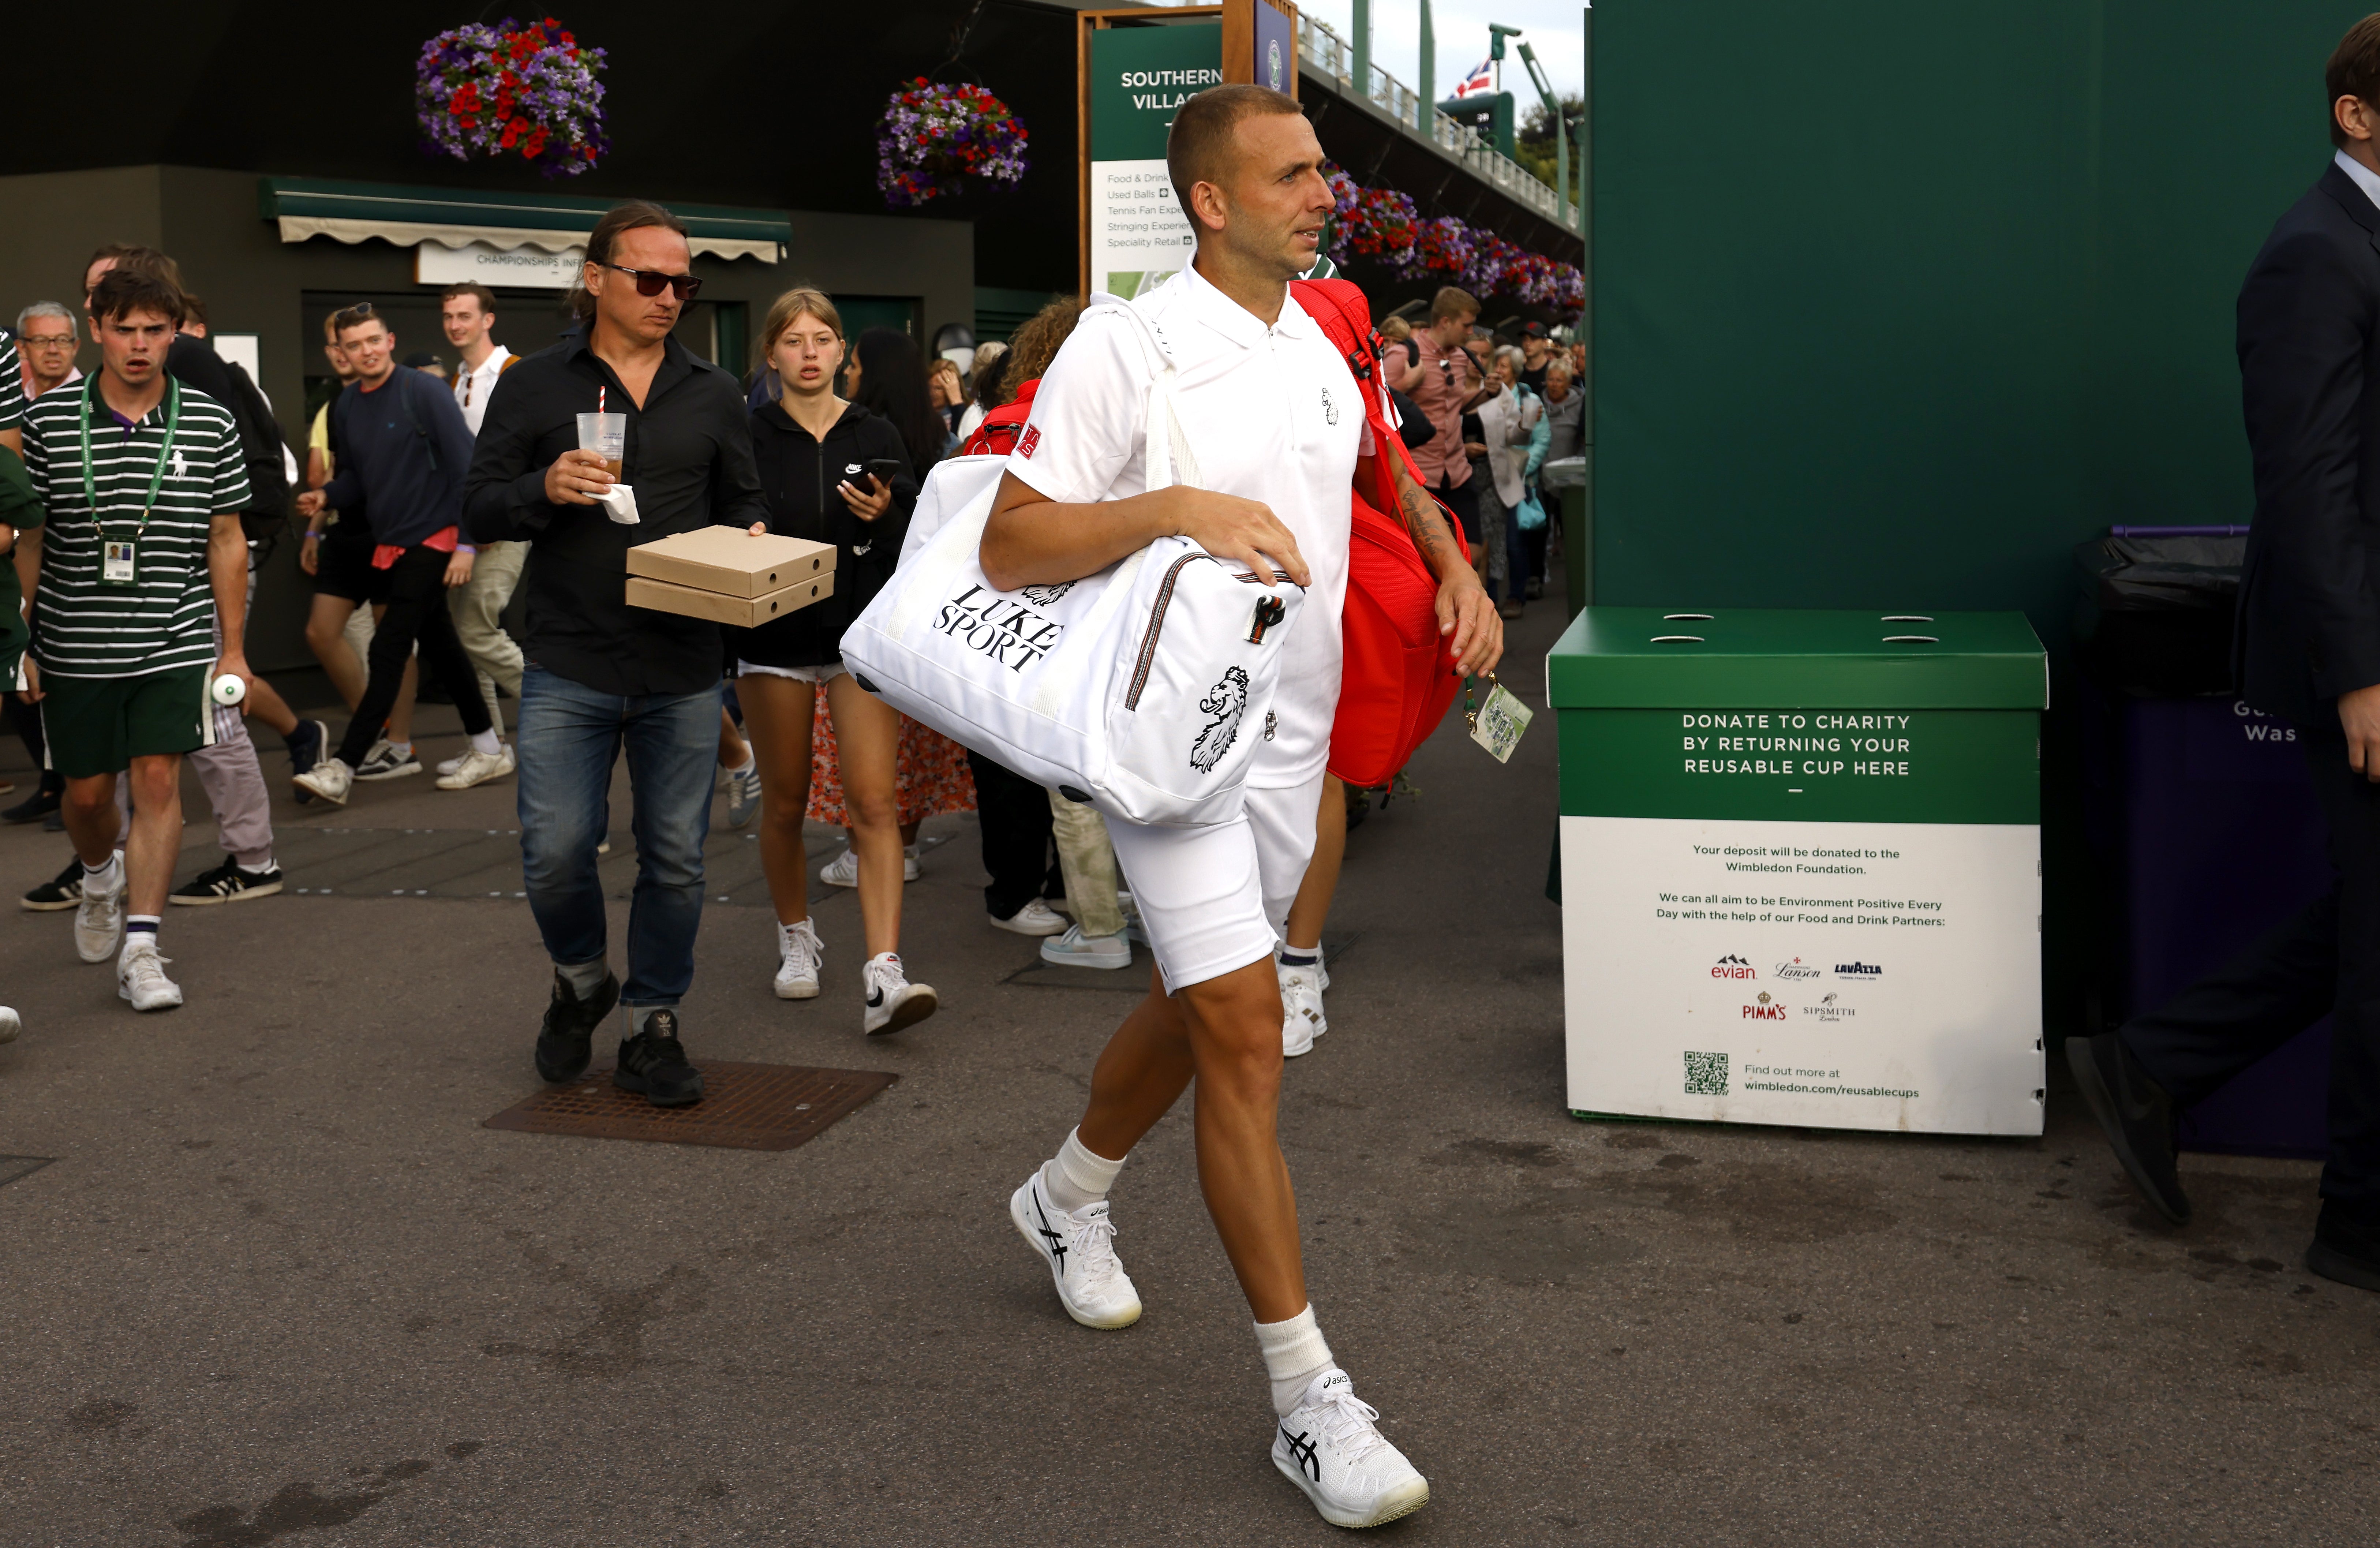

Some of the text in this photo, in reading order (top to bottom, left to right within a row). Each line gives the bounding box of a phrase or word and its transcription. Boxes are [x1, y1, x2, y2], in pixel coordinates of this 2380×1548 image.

[1121, 68, 1223, 87] SOUTHERN
[1145, 174, 1169, 182] Drink
[1108, 190, 1155, 199] Used Balls
[1108, 207, 1136, 215] Tennis
[1108, 223, 1148, 232] Stringing
[1108, 238, 1180, 247] Speciality Retail
[477, 254, 559, 266] CHAMPIONSHIPS
[951, 583, 1065, 651] LUKE
[933, 606, 1044, 673] SPORT
[1684, 715, 1909, 729] DONATE TO CHARITY
[2244, 725, 2296, 741] Was
[1684, 737, 1909, 752] BY RETURNING YOUR
[1685, 759, 1909, 775] REUSABLE CUP HERE
[1694, 845, 1900, 859] Your deposit will be donated to the
[1726, 863, 1866, 874] Wimbledon Foundation.
[1660, 893, 1678, 902] We
[1705, 894, 1718, 903] all
[1722, 895, 1741, 904] aim
[1746, 896, 1757, 905] to
[1762, 896, 1775, 905] be
[1780, 897, 1853, 908] Environment
[1858, 899, 1904, 909] Positive
[1909, 900, 1942, 911] Every
[1657, 909, 1678, 920] Day
[1682, 910, 1706, 919] with
[1710, 911, 1728, 920] the
[1732, 912, 1756, 923] help
[1760, 912, 1771, 921] of
[1799, 914, 1828, 923] Food
[1832, 915, 1853, 924] and
[1858, 916, 1888, 925] Drink
[1893, 916, 1945, 926] Partners:
[1712, 961, 1882, 979] evian Lanson LAVAZZA
[1743, 1003, 1855, 1020] PIMM'S SIPSMITH
[1745, 1065, 1770, 1074] Find
[1774, 1067, 1792, 1076] out
[1829, 1069, 1840, 1078] at
[1745, 1081, 1919, 1099] wimbledon.com/reusablecups
